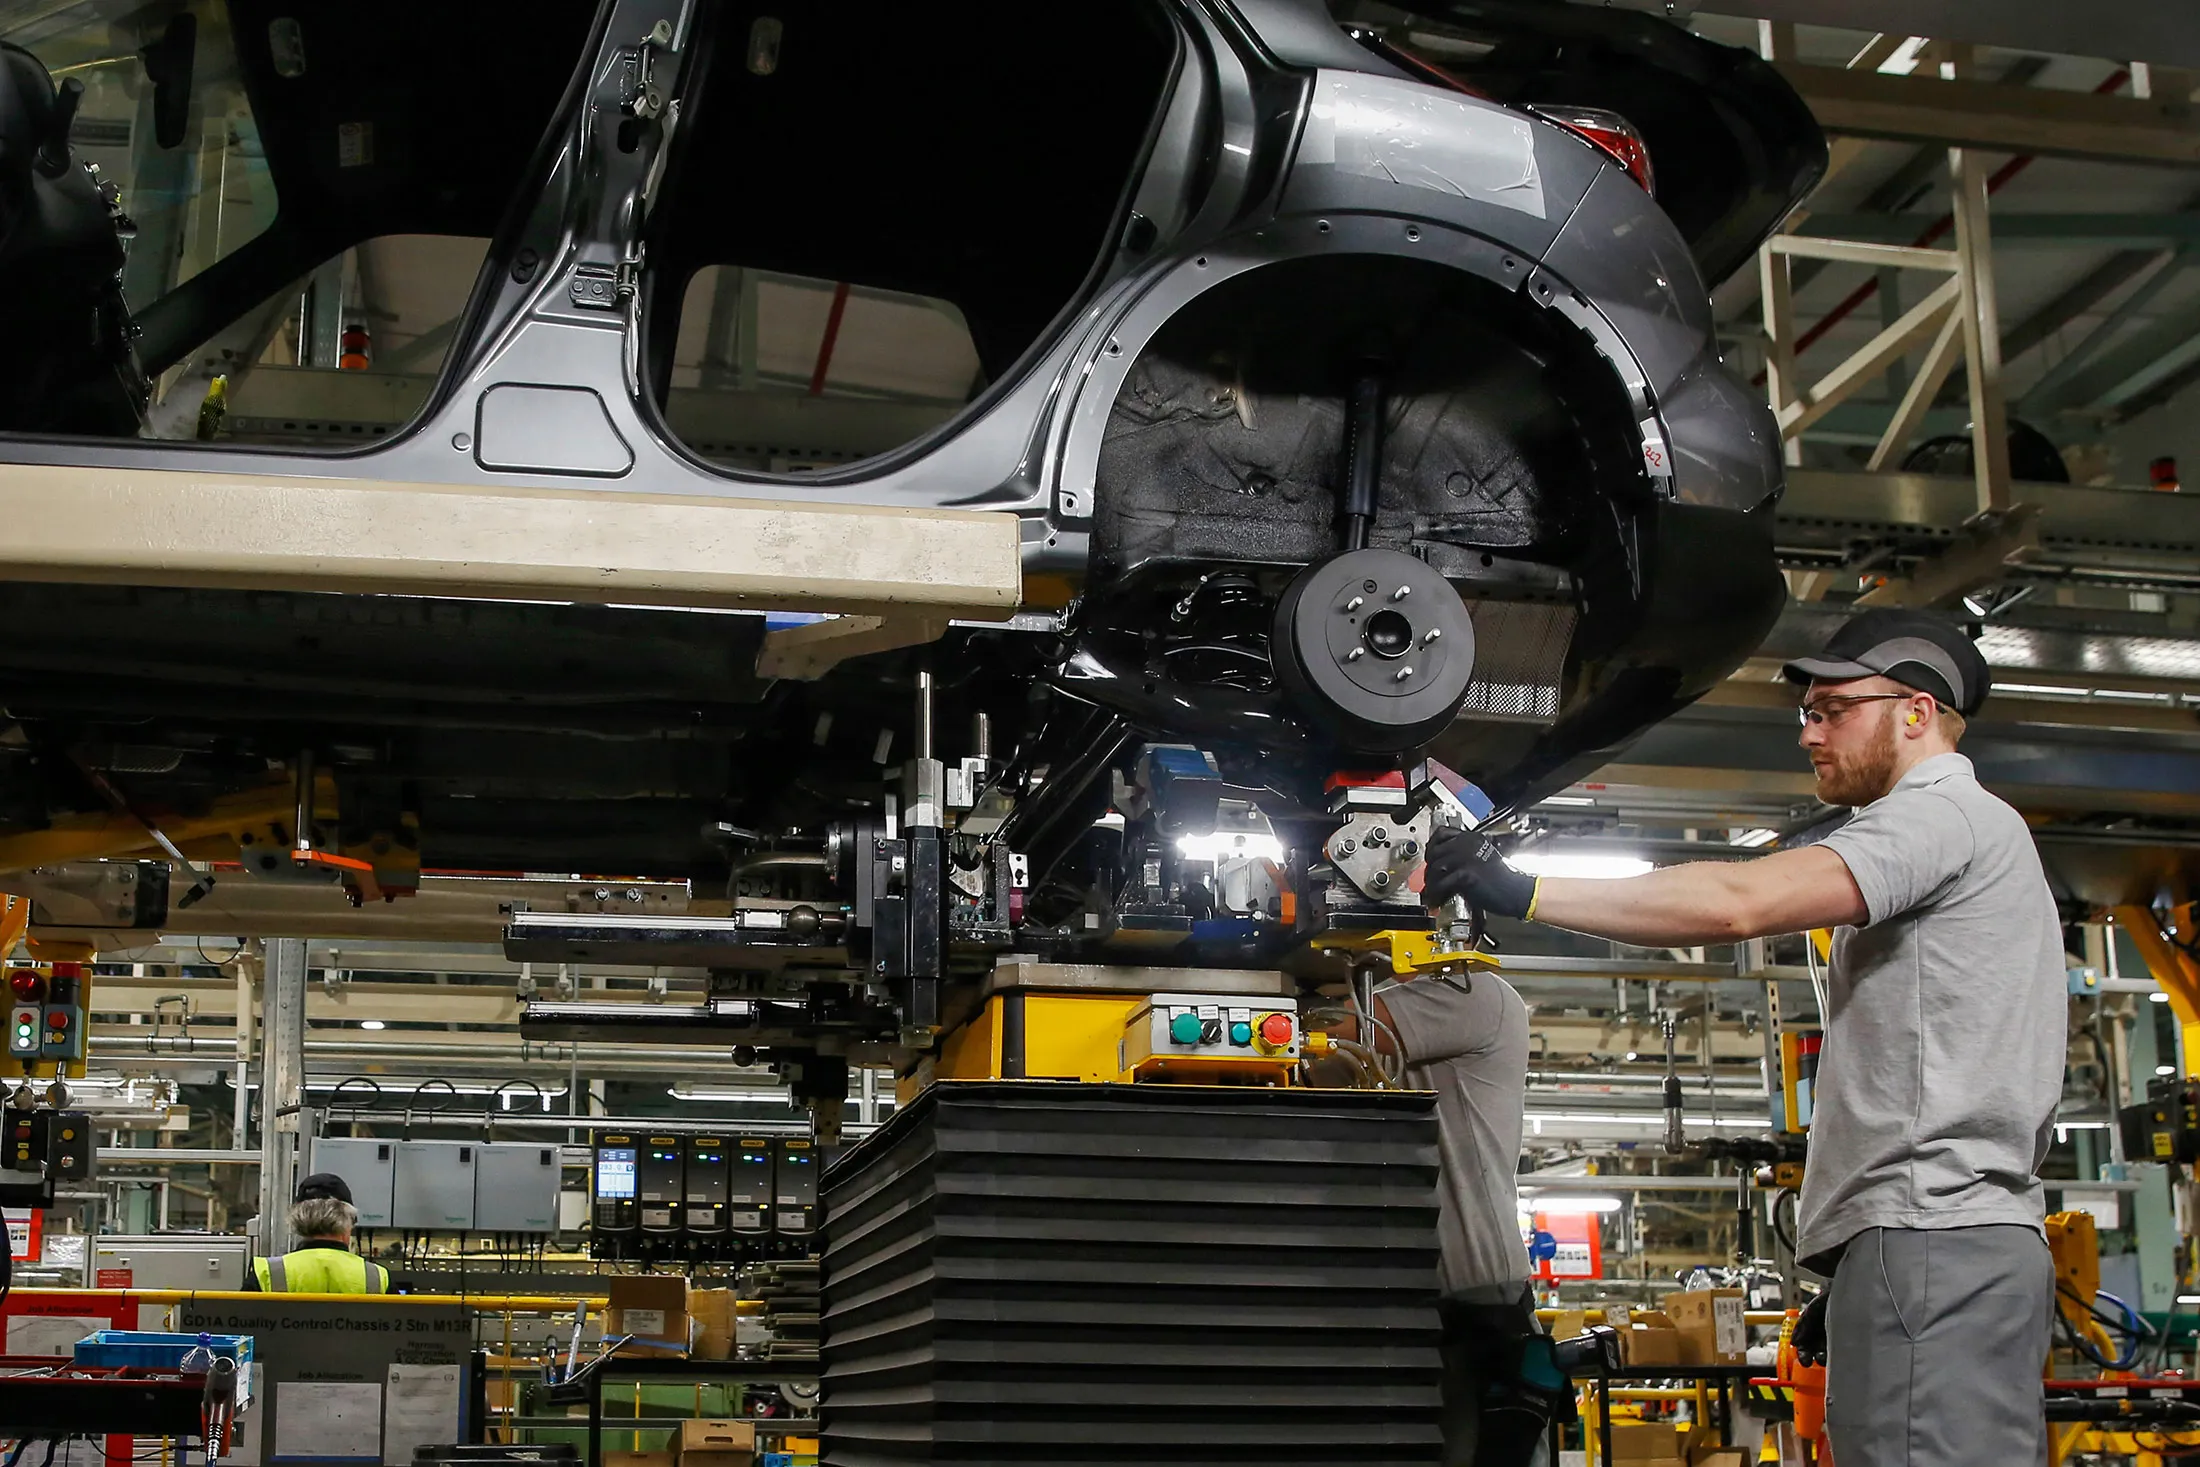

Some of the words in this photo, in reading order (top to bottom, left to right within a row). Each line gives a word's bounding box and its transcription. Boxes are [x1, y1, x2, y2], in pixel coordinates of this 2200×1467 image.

[26, 1305, 44, 1313] Job
[46, 1305, 94, 1314] Allocation
[183, 1314, 224, 1328] GD1A
[228, 1315, 277, 1331] Quality
[281, 1317, 332, 1330] Control
[335, 1318, 391, 1331] Chassis
[395, 1319, 402, 1331] 2
[406, 1319, 430, 1332] Stn
[434, 1320, 471, 1333] M13R
[298, 1370, 314, 1380] Job
[315, 1371, 364, 1380] Allocation
